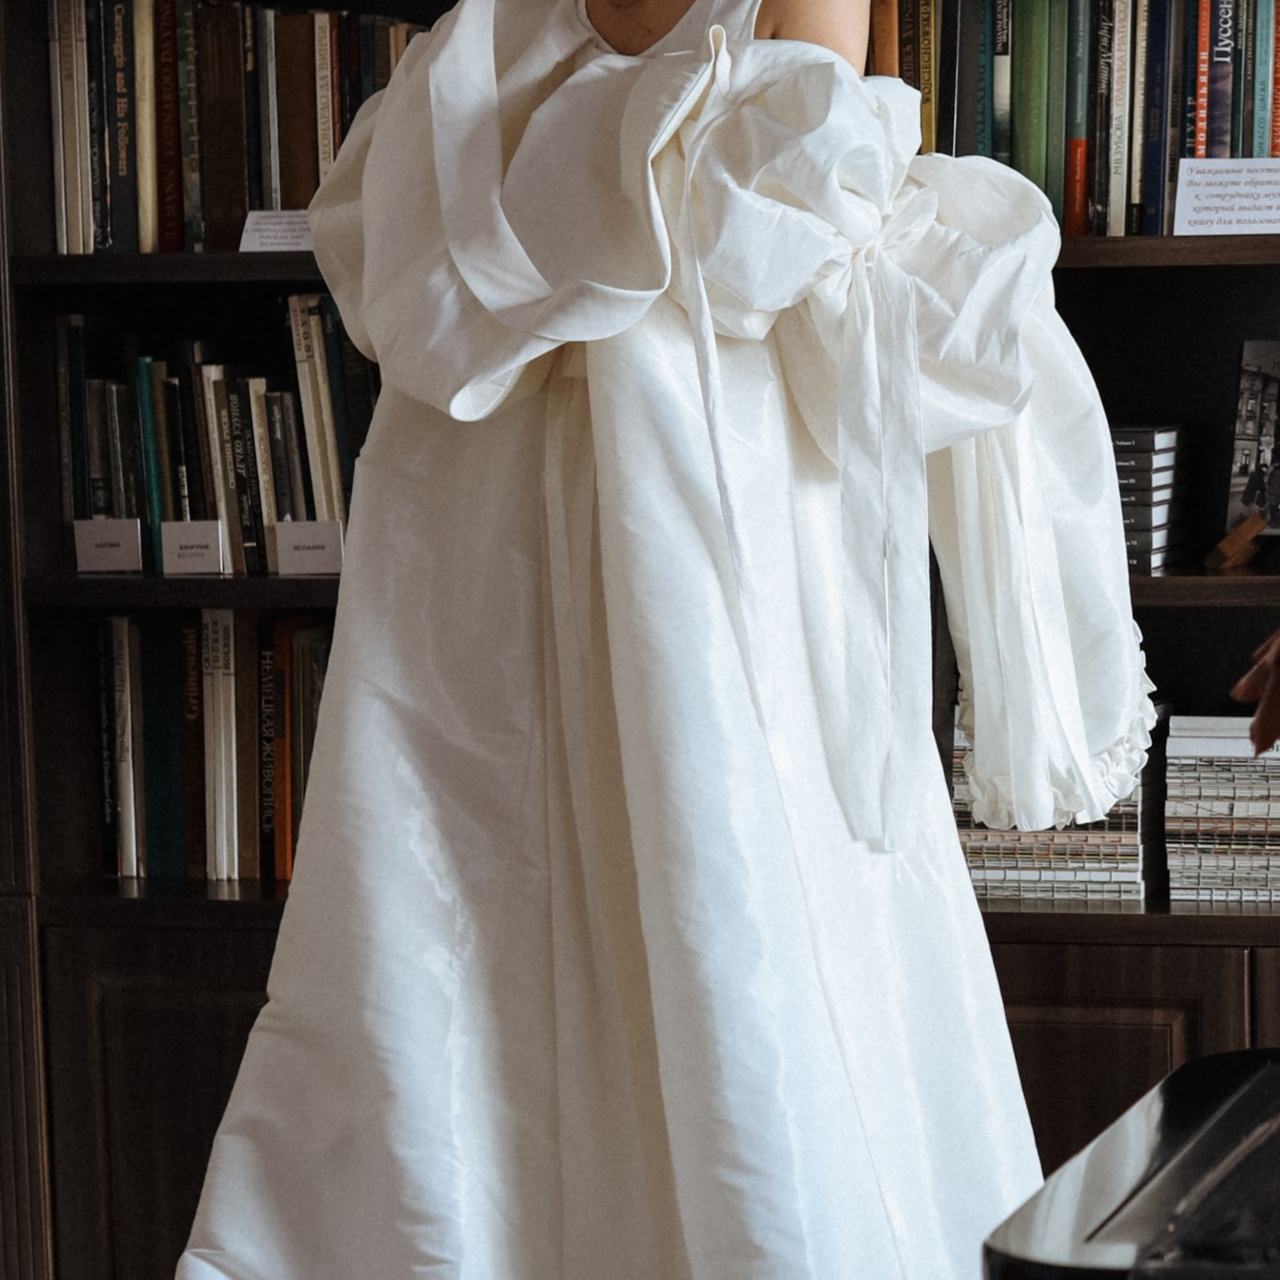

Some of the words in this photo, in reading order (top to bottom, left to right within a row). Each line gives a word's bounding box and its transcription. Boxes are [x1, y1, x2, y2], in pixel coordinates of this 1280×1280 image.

[1186, 166, 1244, 175] Уважаемые
[1203, 180, 1242, 188] можете
[182, 628, 199, 719] Grünewald
[261, 650, 275, 738] НЕМЕЦКАЯ
[262, 741, 275, 833] ЖИВОПИСЬ
